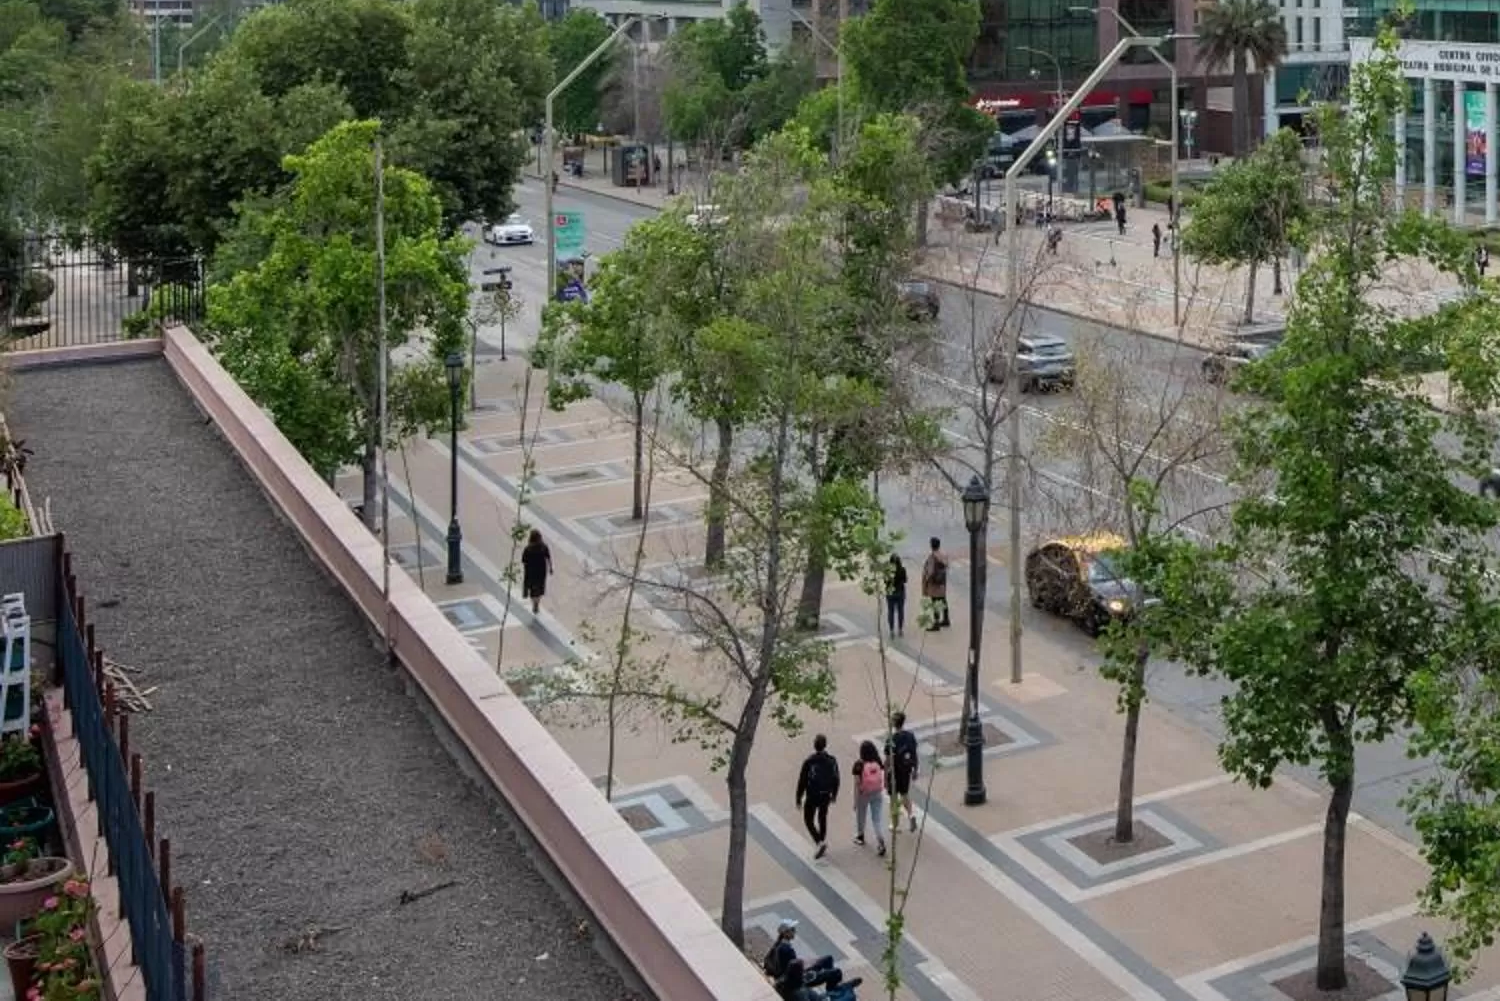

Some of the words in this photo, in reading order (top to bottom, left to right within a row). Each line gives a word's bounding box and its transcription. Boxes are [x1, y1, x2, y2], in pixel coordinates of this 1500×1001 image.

[1439, 50, 1471, 60] CENTRO
[1399, 60, 1429, 71] TEATRO
[1433, 62, 1477, 74] MUNICIPAL
[1480, 64, 1491, 75] DE
